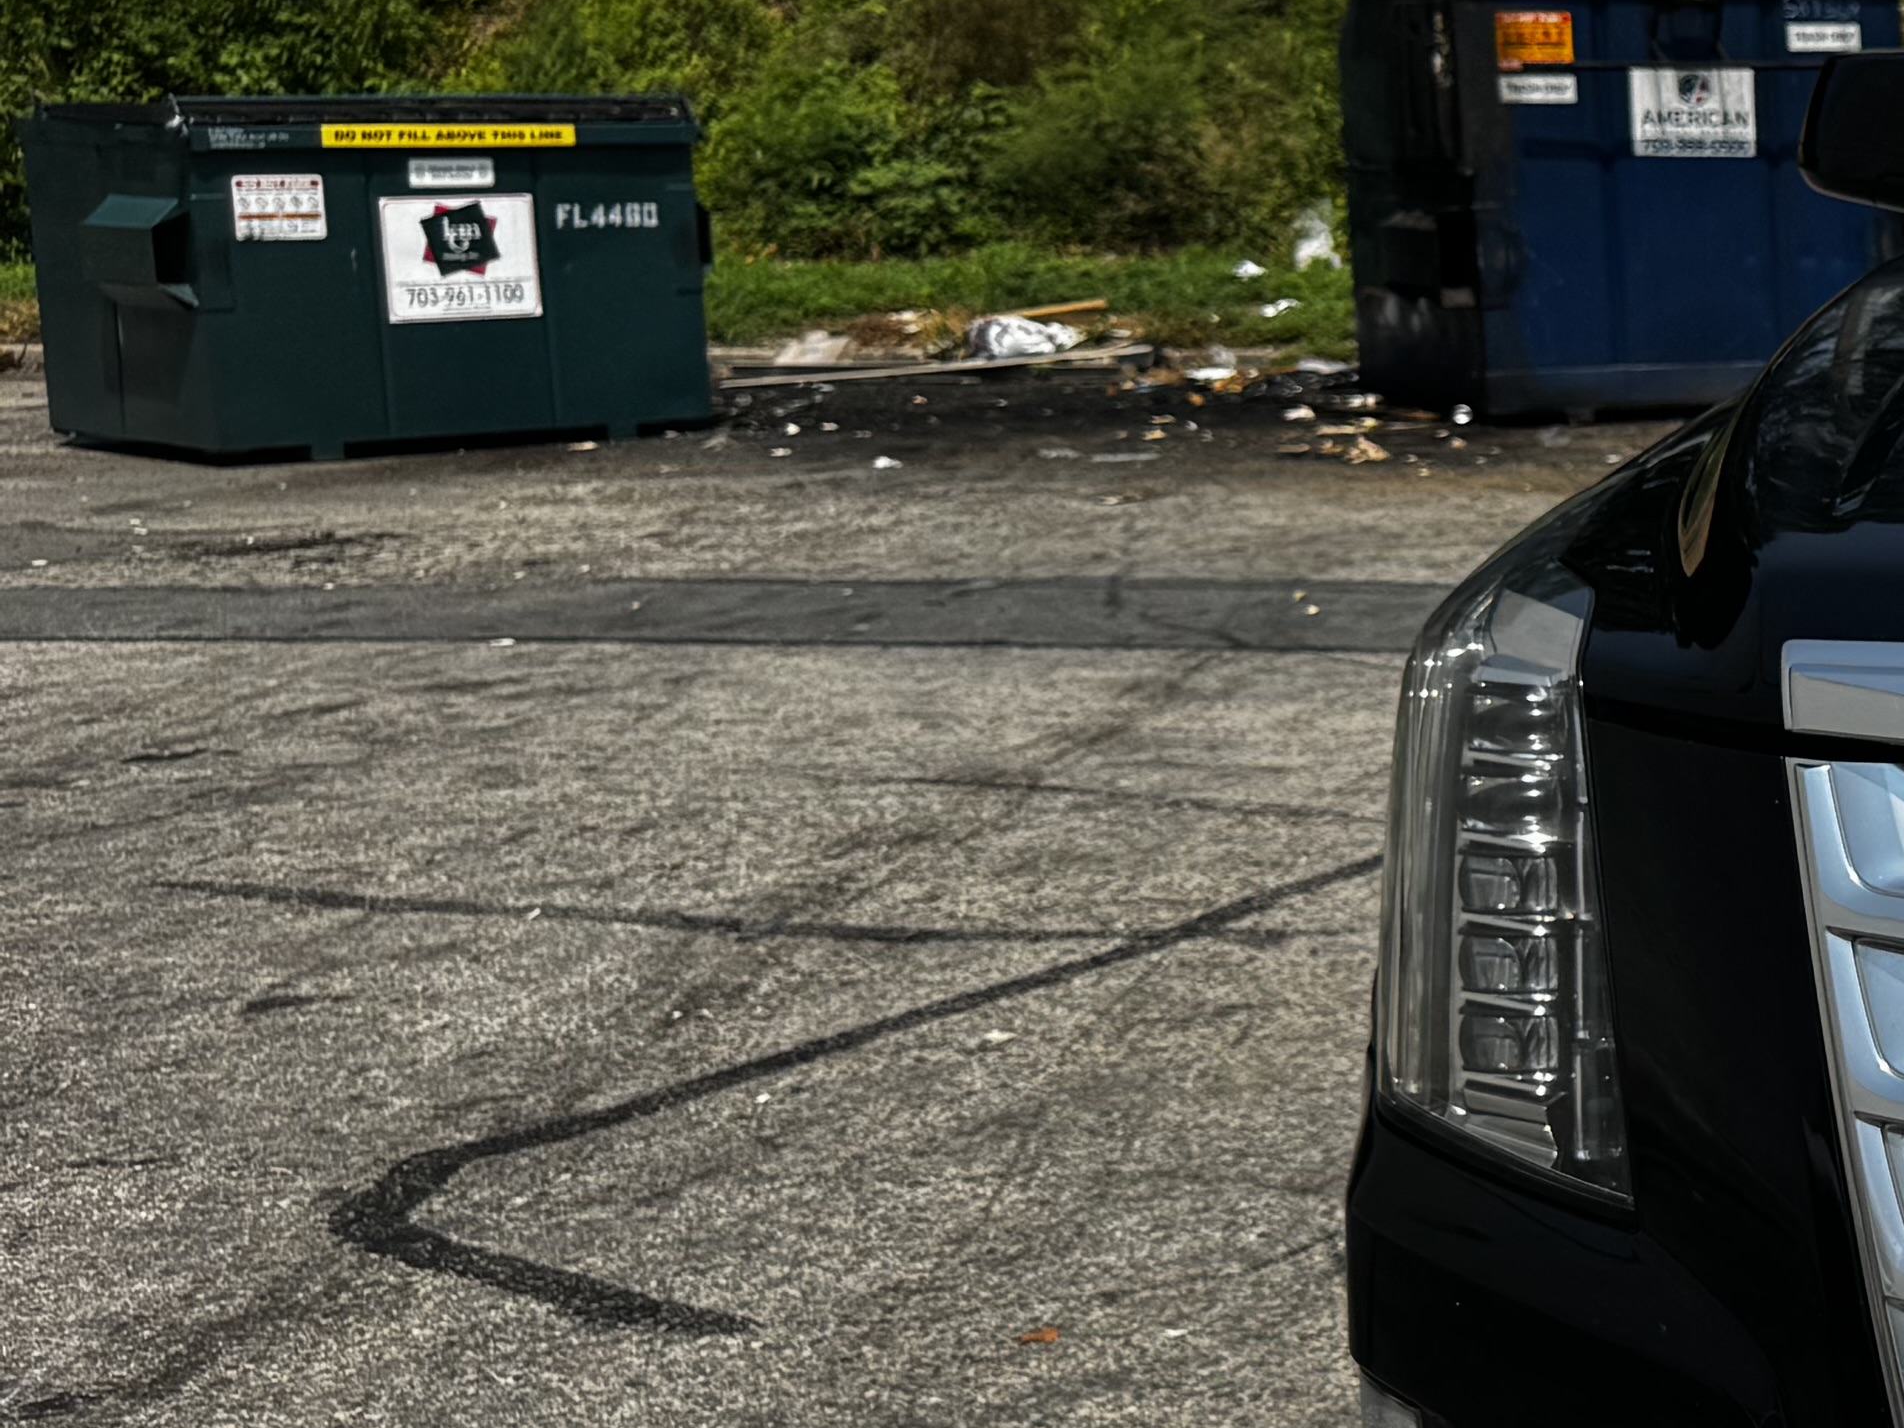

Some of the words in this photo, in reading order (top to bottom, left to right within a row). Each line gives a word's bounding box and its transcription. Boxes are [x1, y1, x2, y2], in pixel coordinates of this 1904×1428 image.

[1641, 109, 1750, 127] AMERICAN
[334, 130, 356, 142] DO
[361, 130, 393, 142] NOT
[398, 130, 431, 142] FILL
[436, 129, 486, 141] ABOVE
